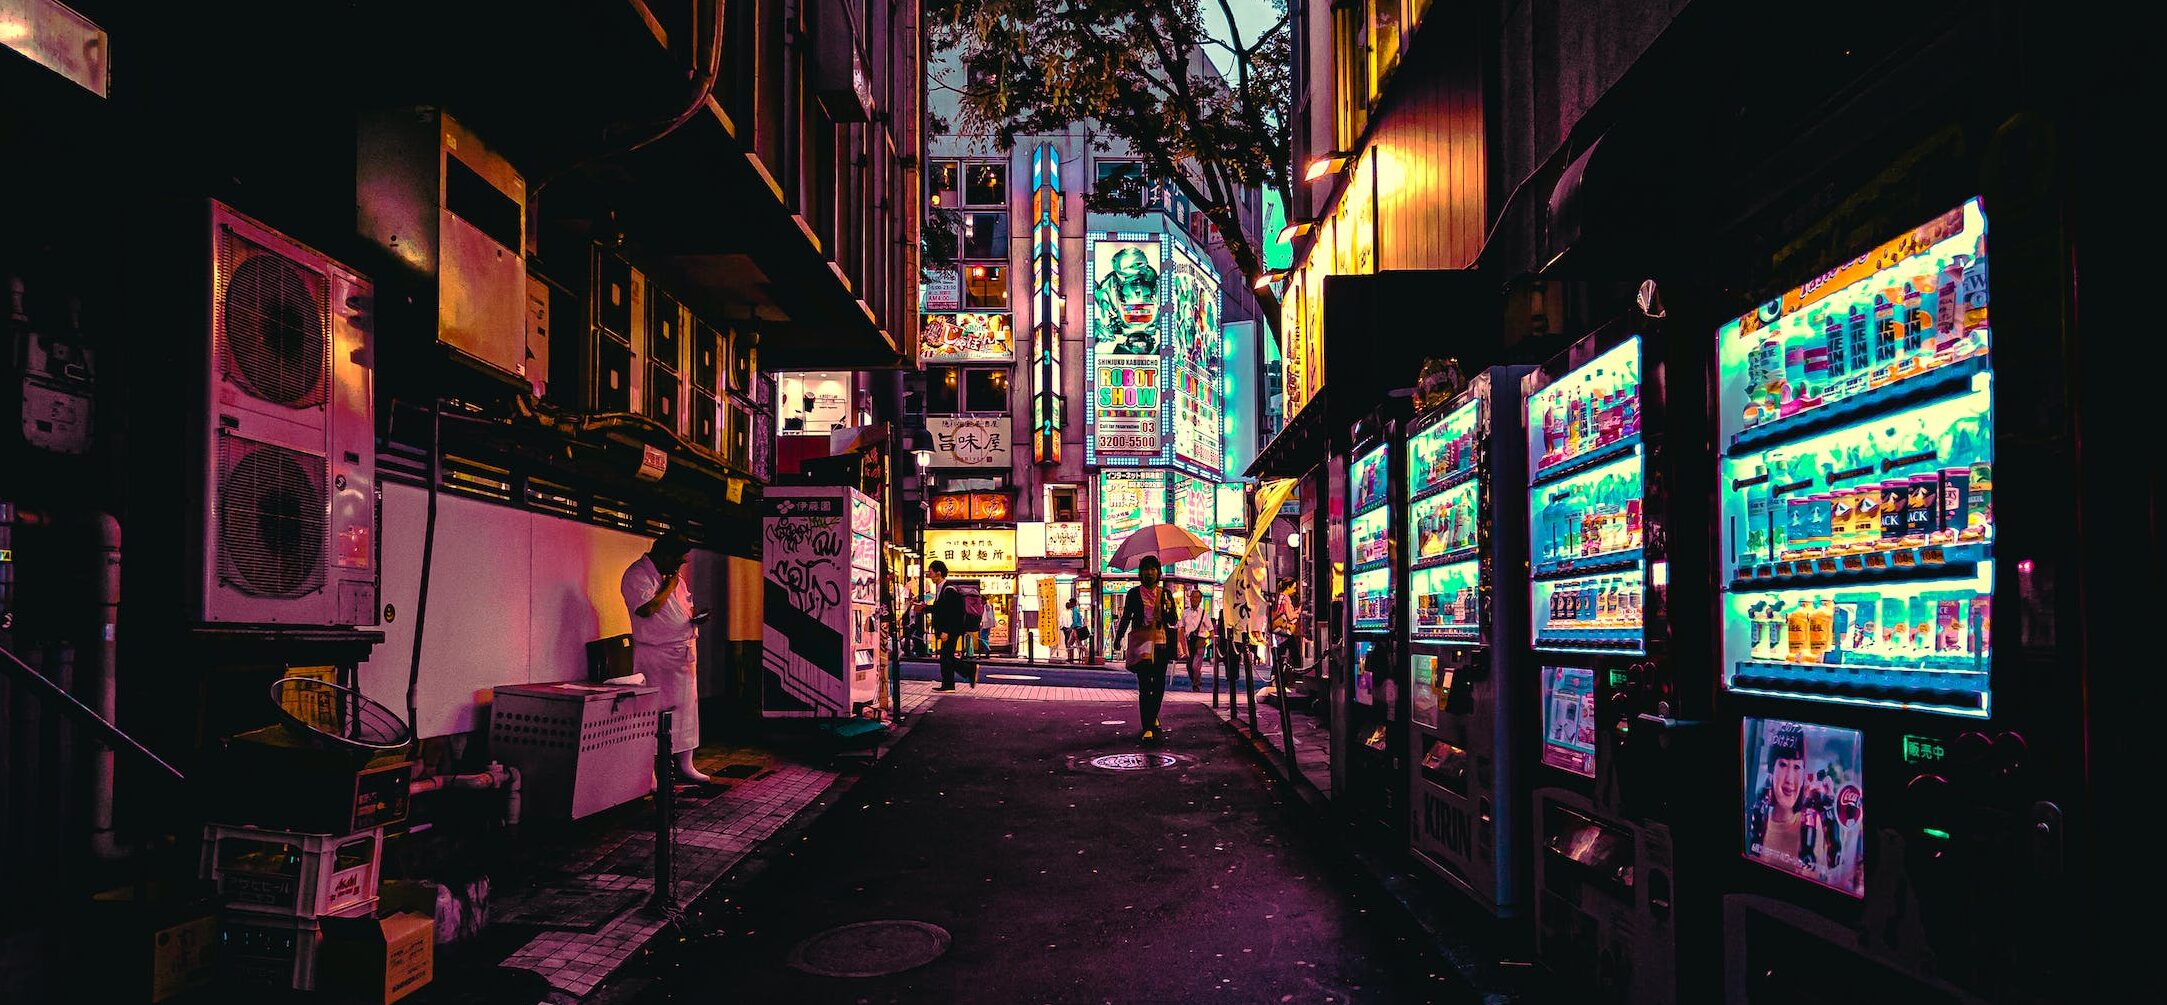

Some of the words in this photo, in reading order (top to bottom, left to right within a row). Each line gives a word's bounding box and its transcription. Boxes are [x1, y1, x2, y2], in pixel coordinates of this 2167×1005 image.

[1043, 212, 1050, 226] 5
[1043, 282, 1050, 296] 4
[1043, 350, 1051, 365] 3
[1099, 368, 1156, 387] ROBOT
[1099, 387, 1156, 406] SHOW
[1043, 419, 1051, 435] 2
[1142, 422, 1155, 433] 03
[938, 433, 1005, 453] 旨味屋
[1100, 436, 1155, 447] 3200-5500
[796, 501, 831, 511] 伊藤園
[927, 549, 1004, 561] 三田製麺所
[1908, 741, 1945, 760] 販売中
